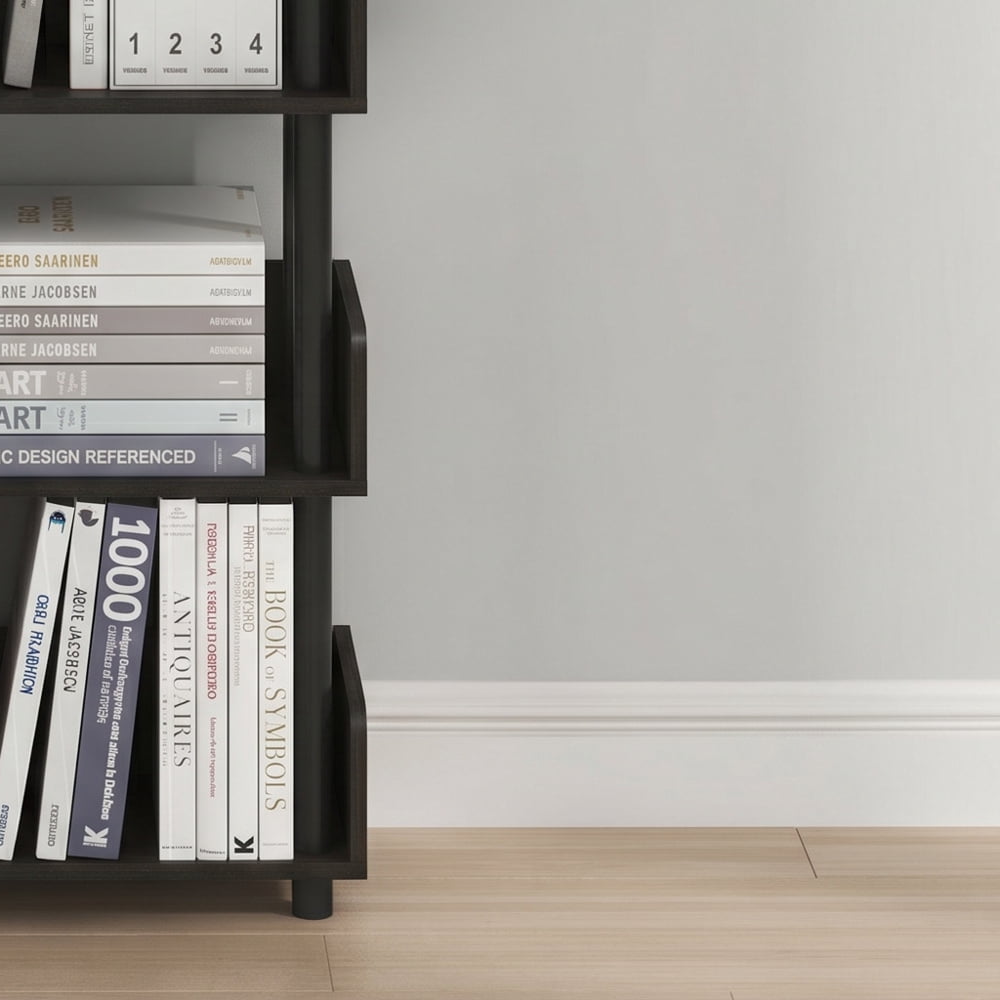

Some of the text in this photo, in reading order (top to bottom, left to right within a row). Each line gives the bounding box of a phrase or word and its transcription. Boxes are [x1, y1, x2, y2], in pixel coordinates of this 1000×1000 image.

[128, 32, 138, 55] 1
[169, 32, 182, 55] 2
[210, 32, 223, 55] 3
[249, 32, 263, 55] 4
[34, 254, 98, 268] SAARINEN
[31, 285, 97, 299] JACOBSEN
[34, 314, 98, 328] SAARINEN
[31, 343, 97, 357] JACOBSEN
[18, 449, 80, 465] DESIGN
[85, 449, 196, 465] REFERENCED
[102, 516, 151, 622] 1000
[264, 590, 287, 659] BOOK
[169, 591, 191, 767] ANTIQUAIRES
[264, 687, 287, 811] SYMBOLS
[234, 836, 254, 854] K
